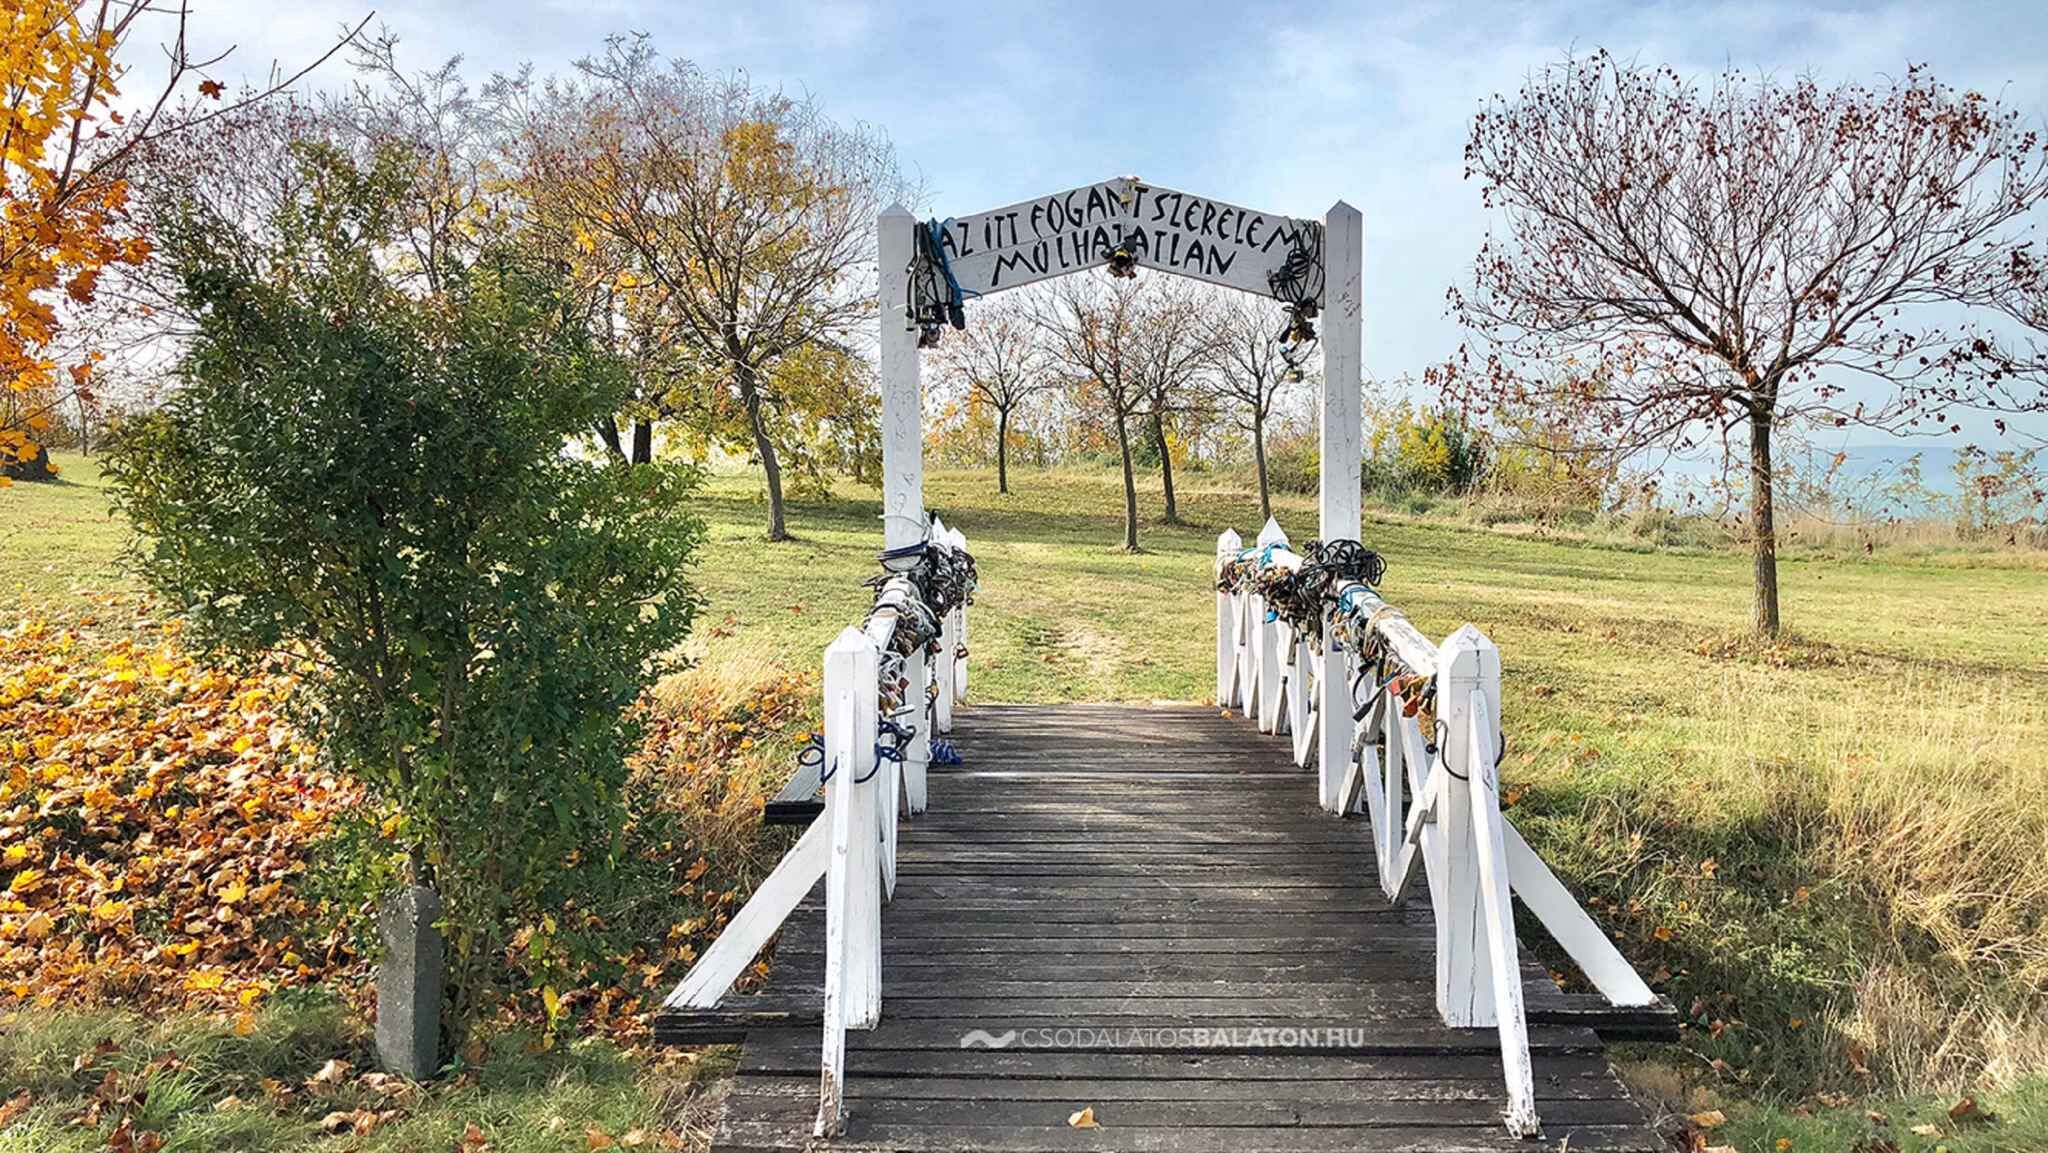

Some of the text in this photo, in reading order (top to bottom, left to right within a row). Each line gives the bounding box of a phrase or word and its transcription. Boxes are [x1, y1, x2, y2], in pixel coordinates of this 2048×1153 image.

[941, 222, 973, 258] AZ
[1031, 186, 1149, 240] FOGANT
[1151, 192, 1304, 253] SZERELEM
